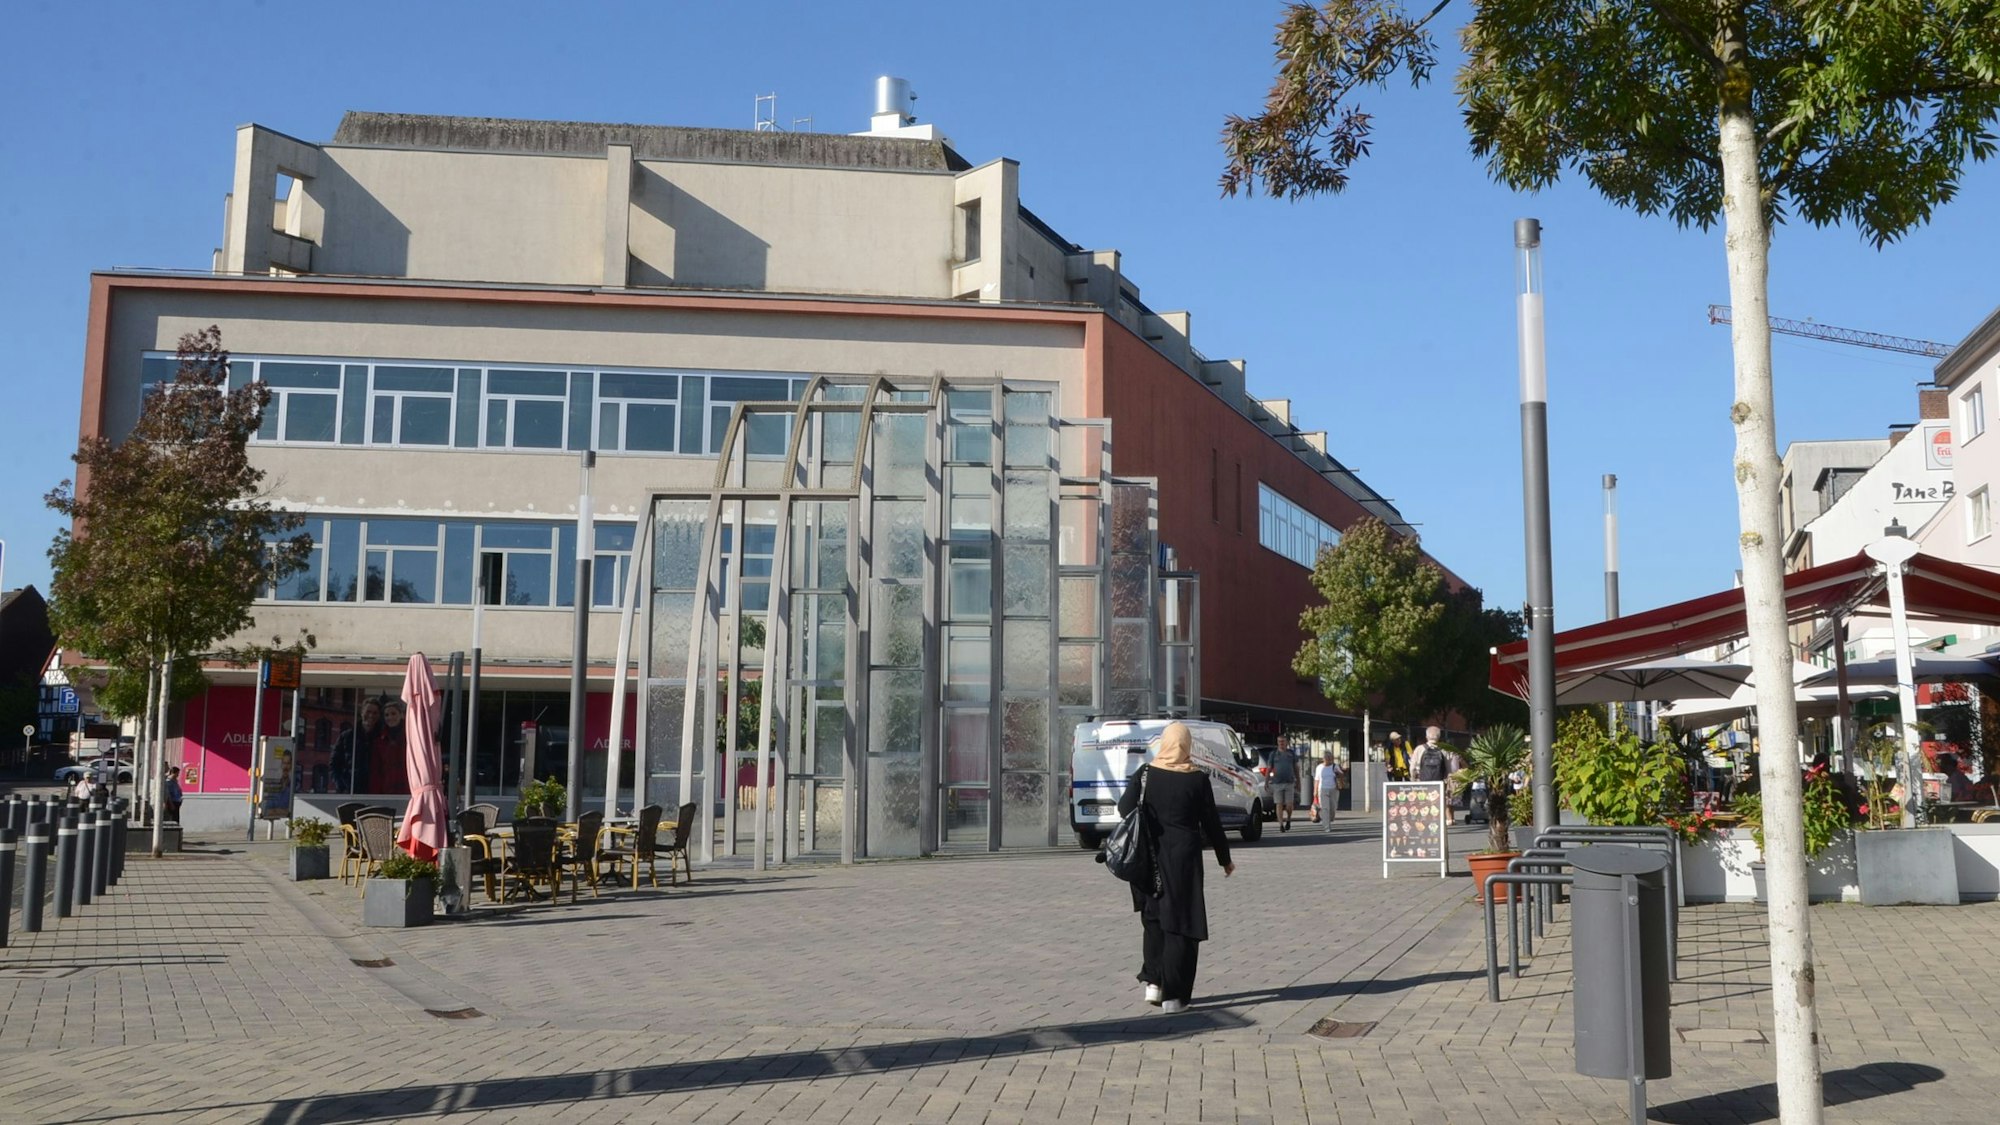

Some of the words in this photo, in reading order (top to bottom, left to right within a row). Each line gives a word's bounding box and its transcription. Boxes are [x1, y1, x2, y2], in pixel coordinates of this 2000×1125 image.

[1942, 480, 1955, 498] B
[65, 692, 75, 704] P
[222, 733, 254, 743] ADLE
[593, 737, 631, 749] ADER
